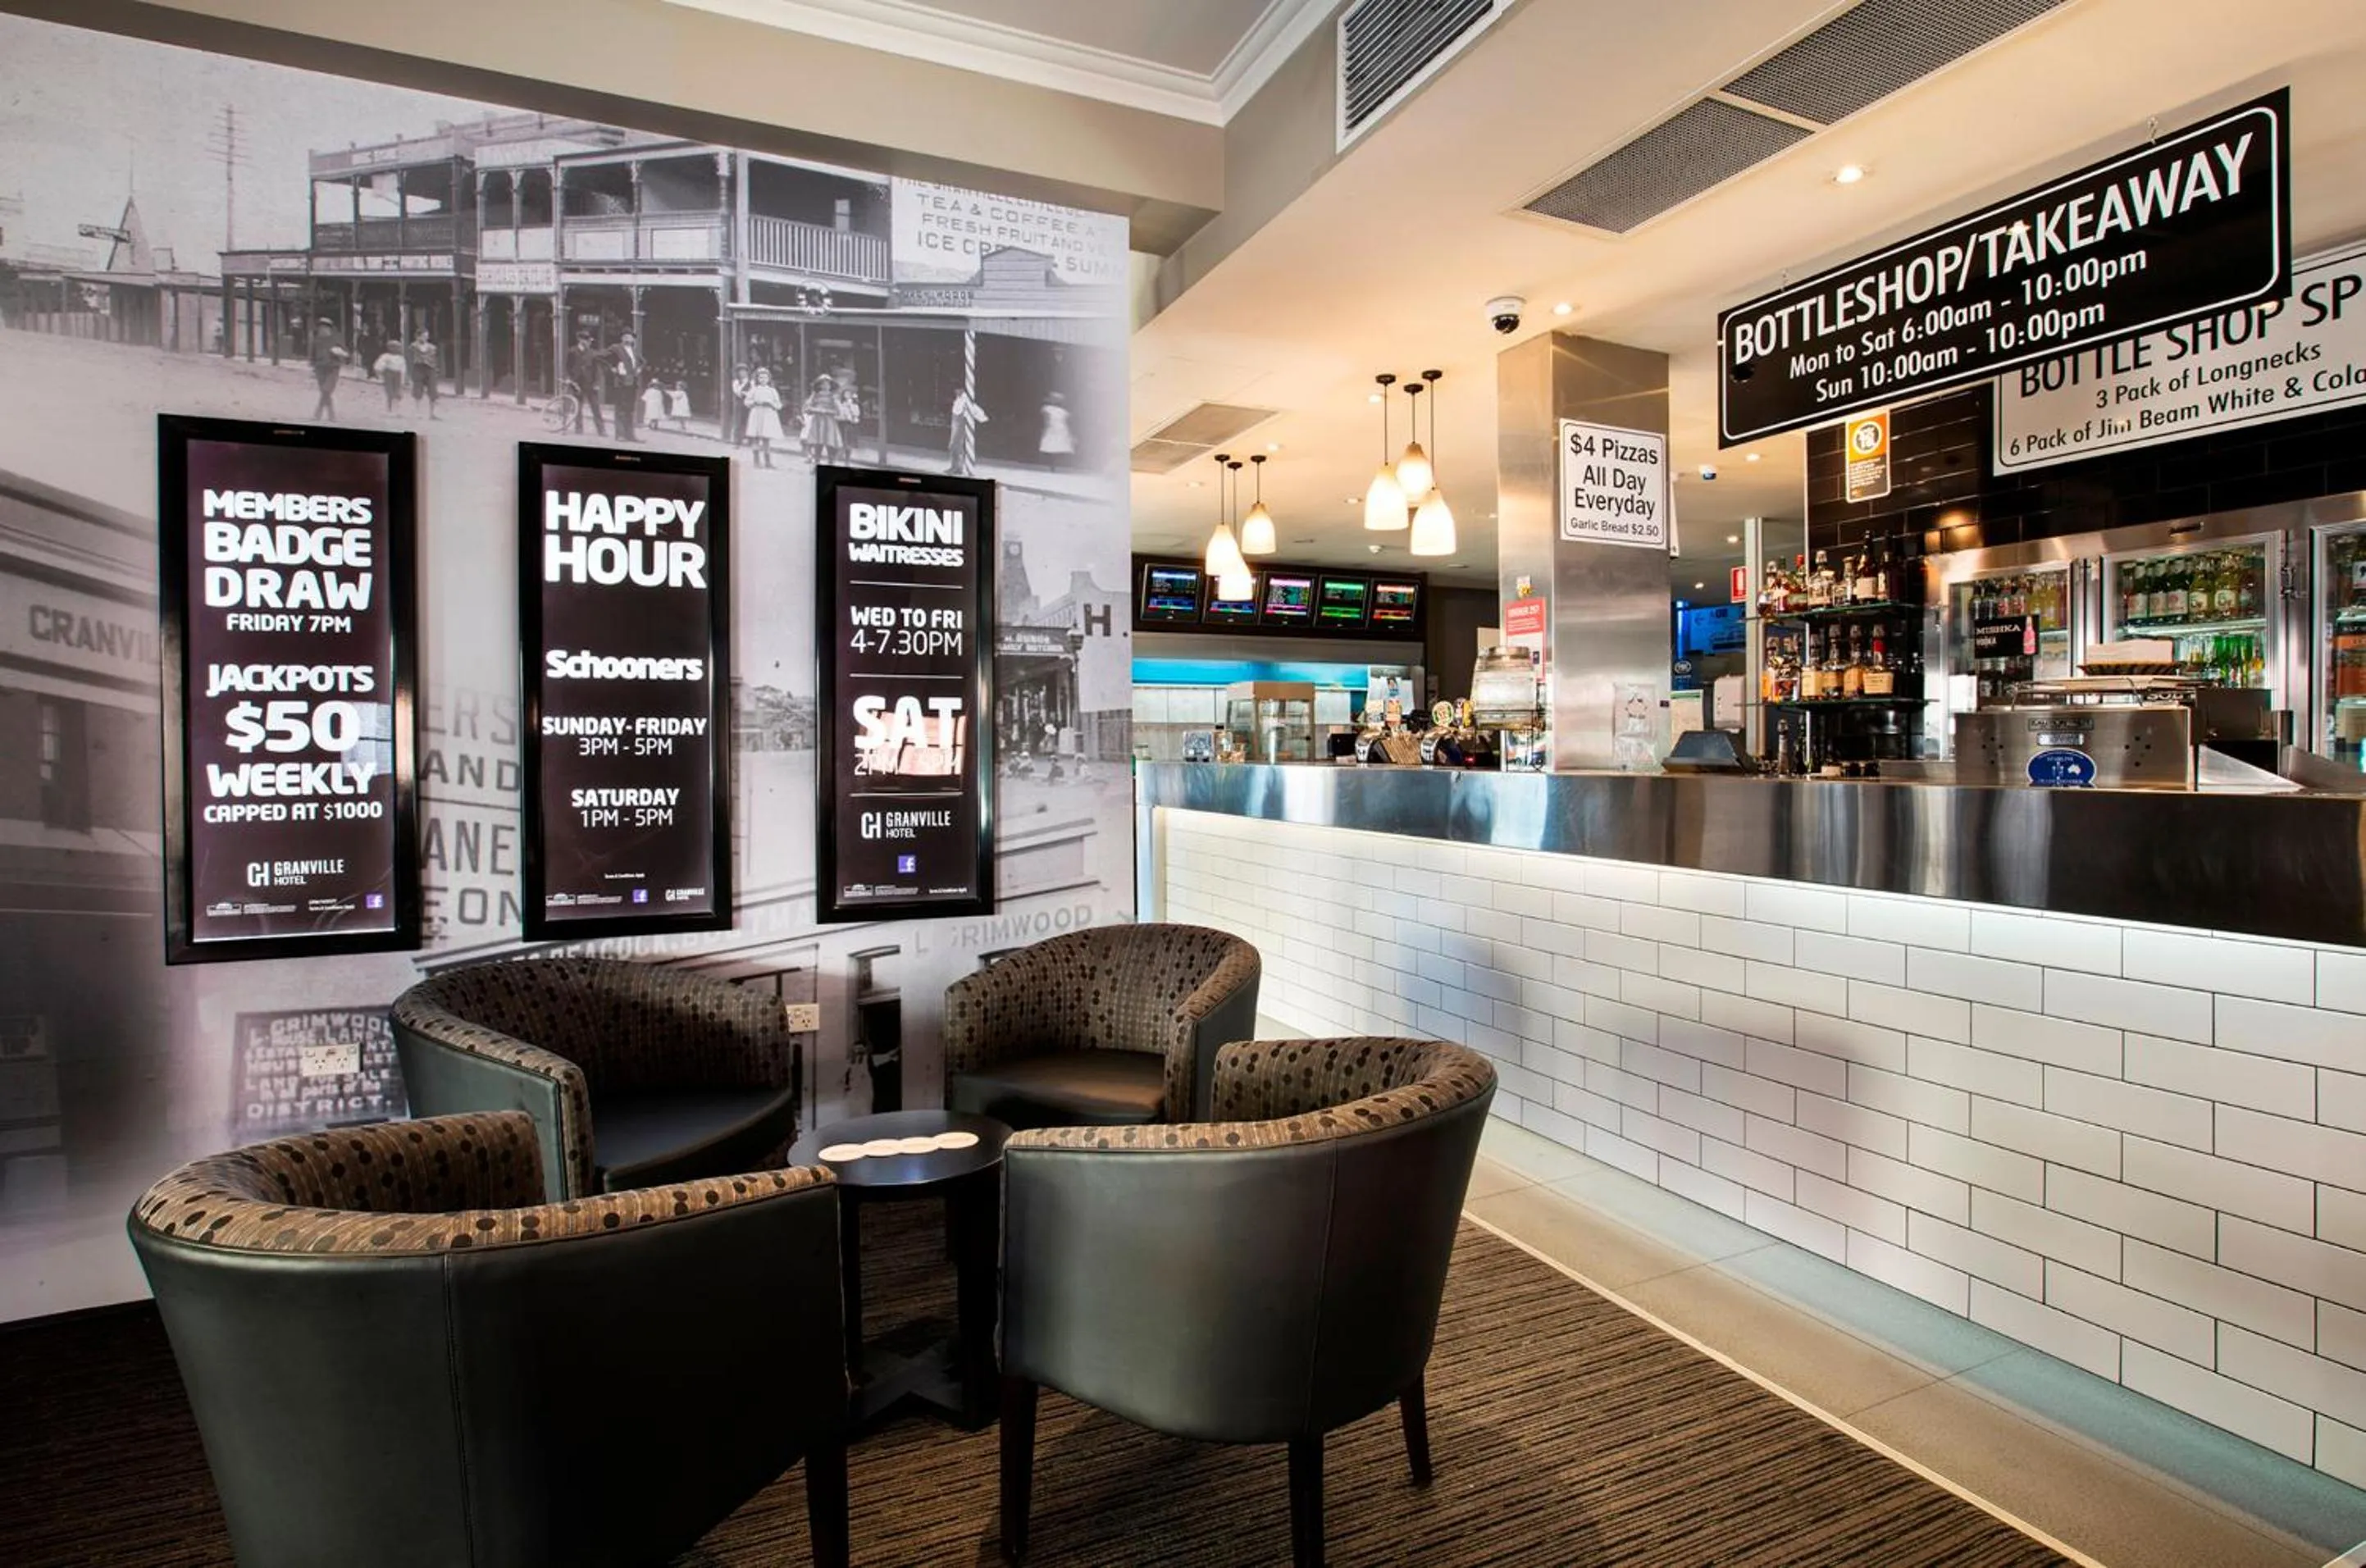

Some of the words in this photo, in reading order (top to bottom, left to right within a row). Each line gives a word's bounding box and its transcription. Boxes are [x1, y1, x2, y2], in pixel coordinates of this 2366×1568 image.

[916, 192, 962, 212] TEA
[922, 213, 991, 235] FRESH
[918, 231, 955, 251] ICE
[1735, 132, 2254, 365] BOTTLESHOP/TAKEAWAY
[1789, 353, 1830, 379] Mon
[1835, 343, 1855, 362] to
[1862, 326, 1896, 357] Sat
[1902, 299, 1992, 344] 6:00am
[2021, 249, 2147, 306] 10:00pm
[2167, 299, 2284, 361] SHOP
[1816, 377, 1853, 402] Sun
[1861, 345, 1958, 390] 10:00am
[1985, 303, 2106, 354] 10:00pm
[2096, 390, 2108, 408] 3
[2115, 377, 2161, 404] Pack
[2168, 368, 2190, 392] of
[2197, 341, 2322, 386] Longnecks
[2010, 438, 2021, 456] 6
[2026, 428, 2067, 453] Pack
[2073, 421, 2092, 443] of
[2096, 418, 2131, 439] Jim
[2140, 404, 2200, 430] Beam
[2208, 387, 2274, 414] White
[2284, 376, 2303, 399] &
[1570, 432, 1596, 457] $4
[1602, 438, 1658, 465] Pizzas
[1583, 465, 1607, 486] All
[1613, 468, 1647, 495] Day
[203, 489, 372, 524] MEMBERS
[545, 490, 705, 538] HAPPY
[1575, 487, 1656, 521] Everyday
[850, 503, 963, 545] BIKINI
[1570, 517, 1599, 531] Garlic
[1601, 520, 1629, 534] Bread
[204, 522, 372, 567] BADGE
[848, 542, 964, 567] WAITRESSES
[545, 534, 707, 589] HOUR
[205, 567, 372, 610] DRAW
[226, 613, 304, 631] FRIDAY
[309, 615, 352, 633] 7PM
[850, 605, 896, 627] WED
[900, 609, 927, 627] TO
[932, 609, 963, 629] FRI
[850, 629, 963, 656] 4-7.30PM
[206, 663, 375, 697] JACKPOTS
[545, 650, 704, 681] Schooners
[225, 700, 361, 753] $50
[853, 695, 963, 749] SAT
[579, 738, 618, 755] 3PM
[634, 738, 672, 755] 5PM
[207, 763, 377, 797] WEEKLY
[203, 804, 287, 823] CAPPED
[292, 803, 319, 821] AT
[324, 801, 383, 820] $1000
[571, 788, 680, 807] SATURDAY
[580, 809, 619, 827] 1PM
[635, 809, 673, 827] 5PM
[886, 811, 951, 827] GRANVILLE
[886, 827, 916, 838] HOTEL
[274, 859, 344, 877] GRANVILLE
[274, 875, 307, 886] HOTEL
